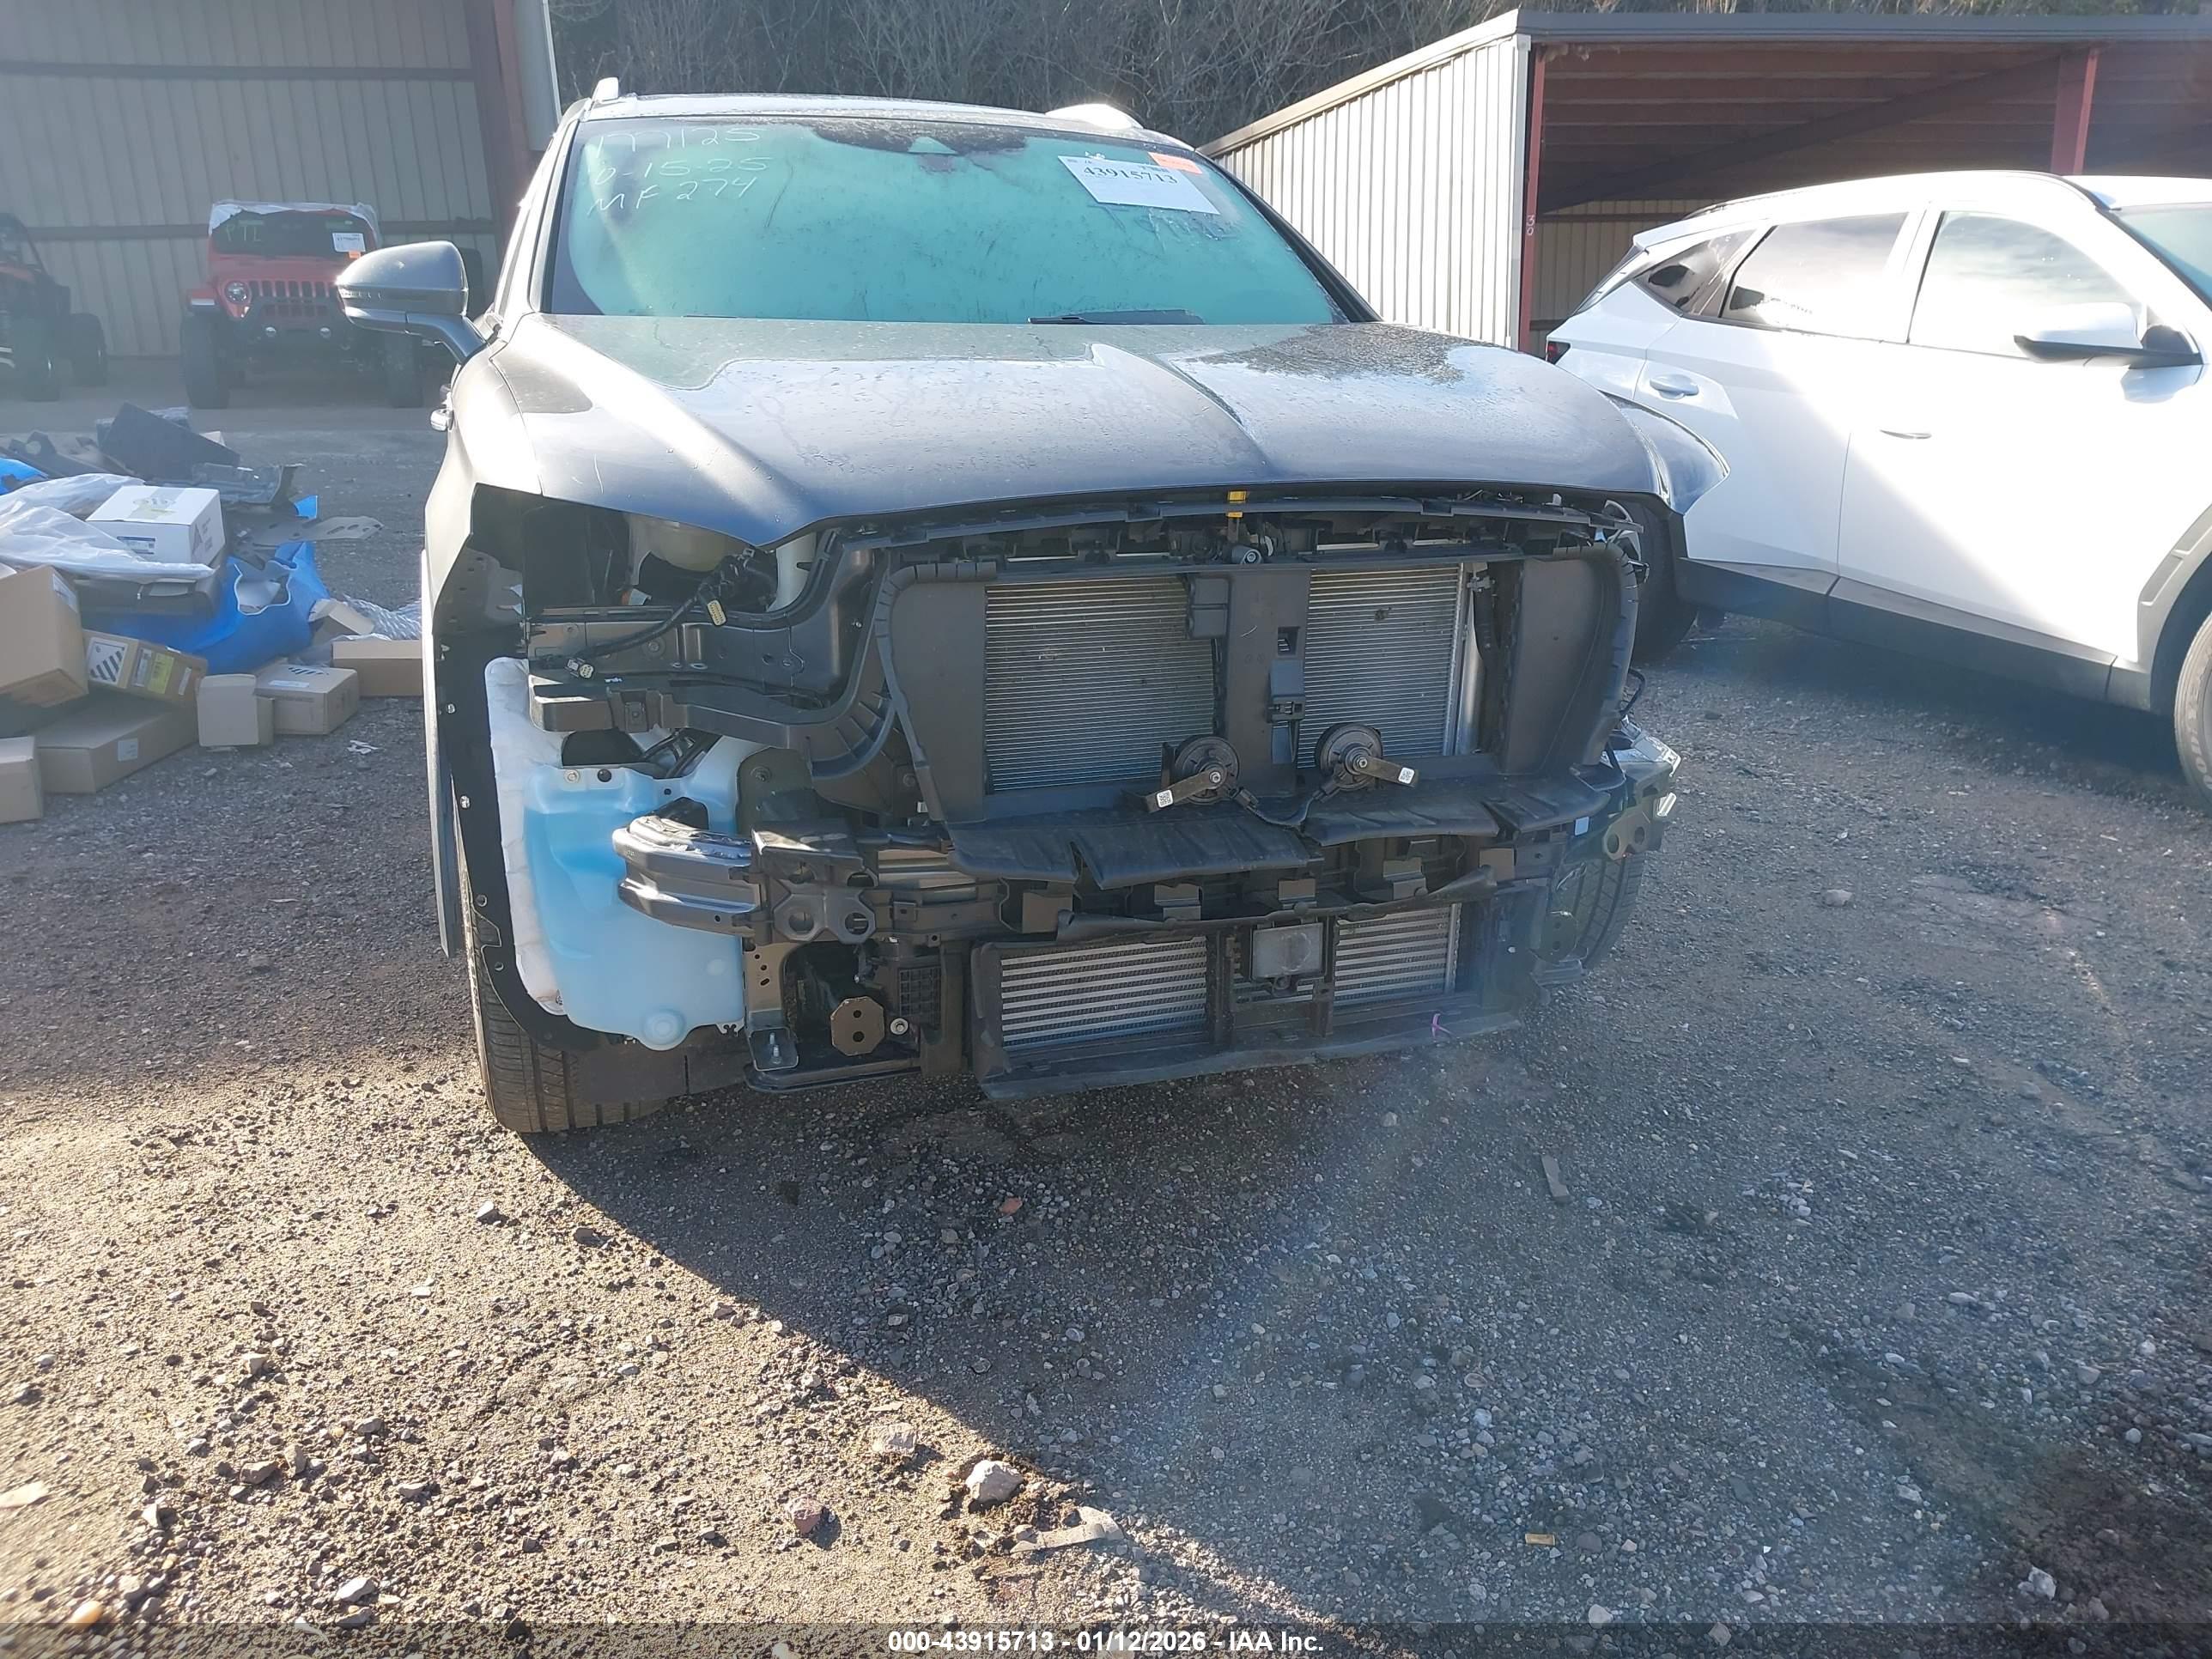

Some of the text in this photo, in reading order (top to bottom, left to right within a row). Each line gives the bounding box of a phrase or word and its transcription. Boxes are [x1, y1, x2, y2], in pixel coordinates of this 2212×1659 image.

[596, 127, 769, 159] 177125
[1084, 166, 1178, 185] 43915713
[676, 176, 757, 200] 274
